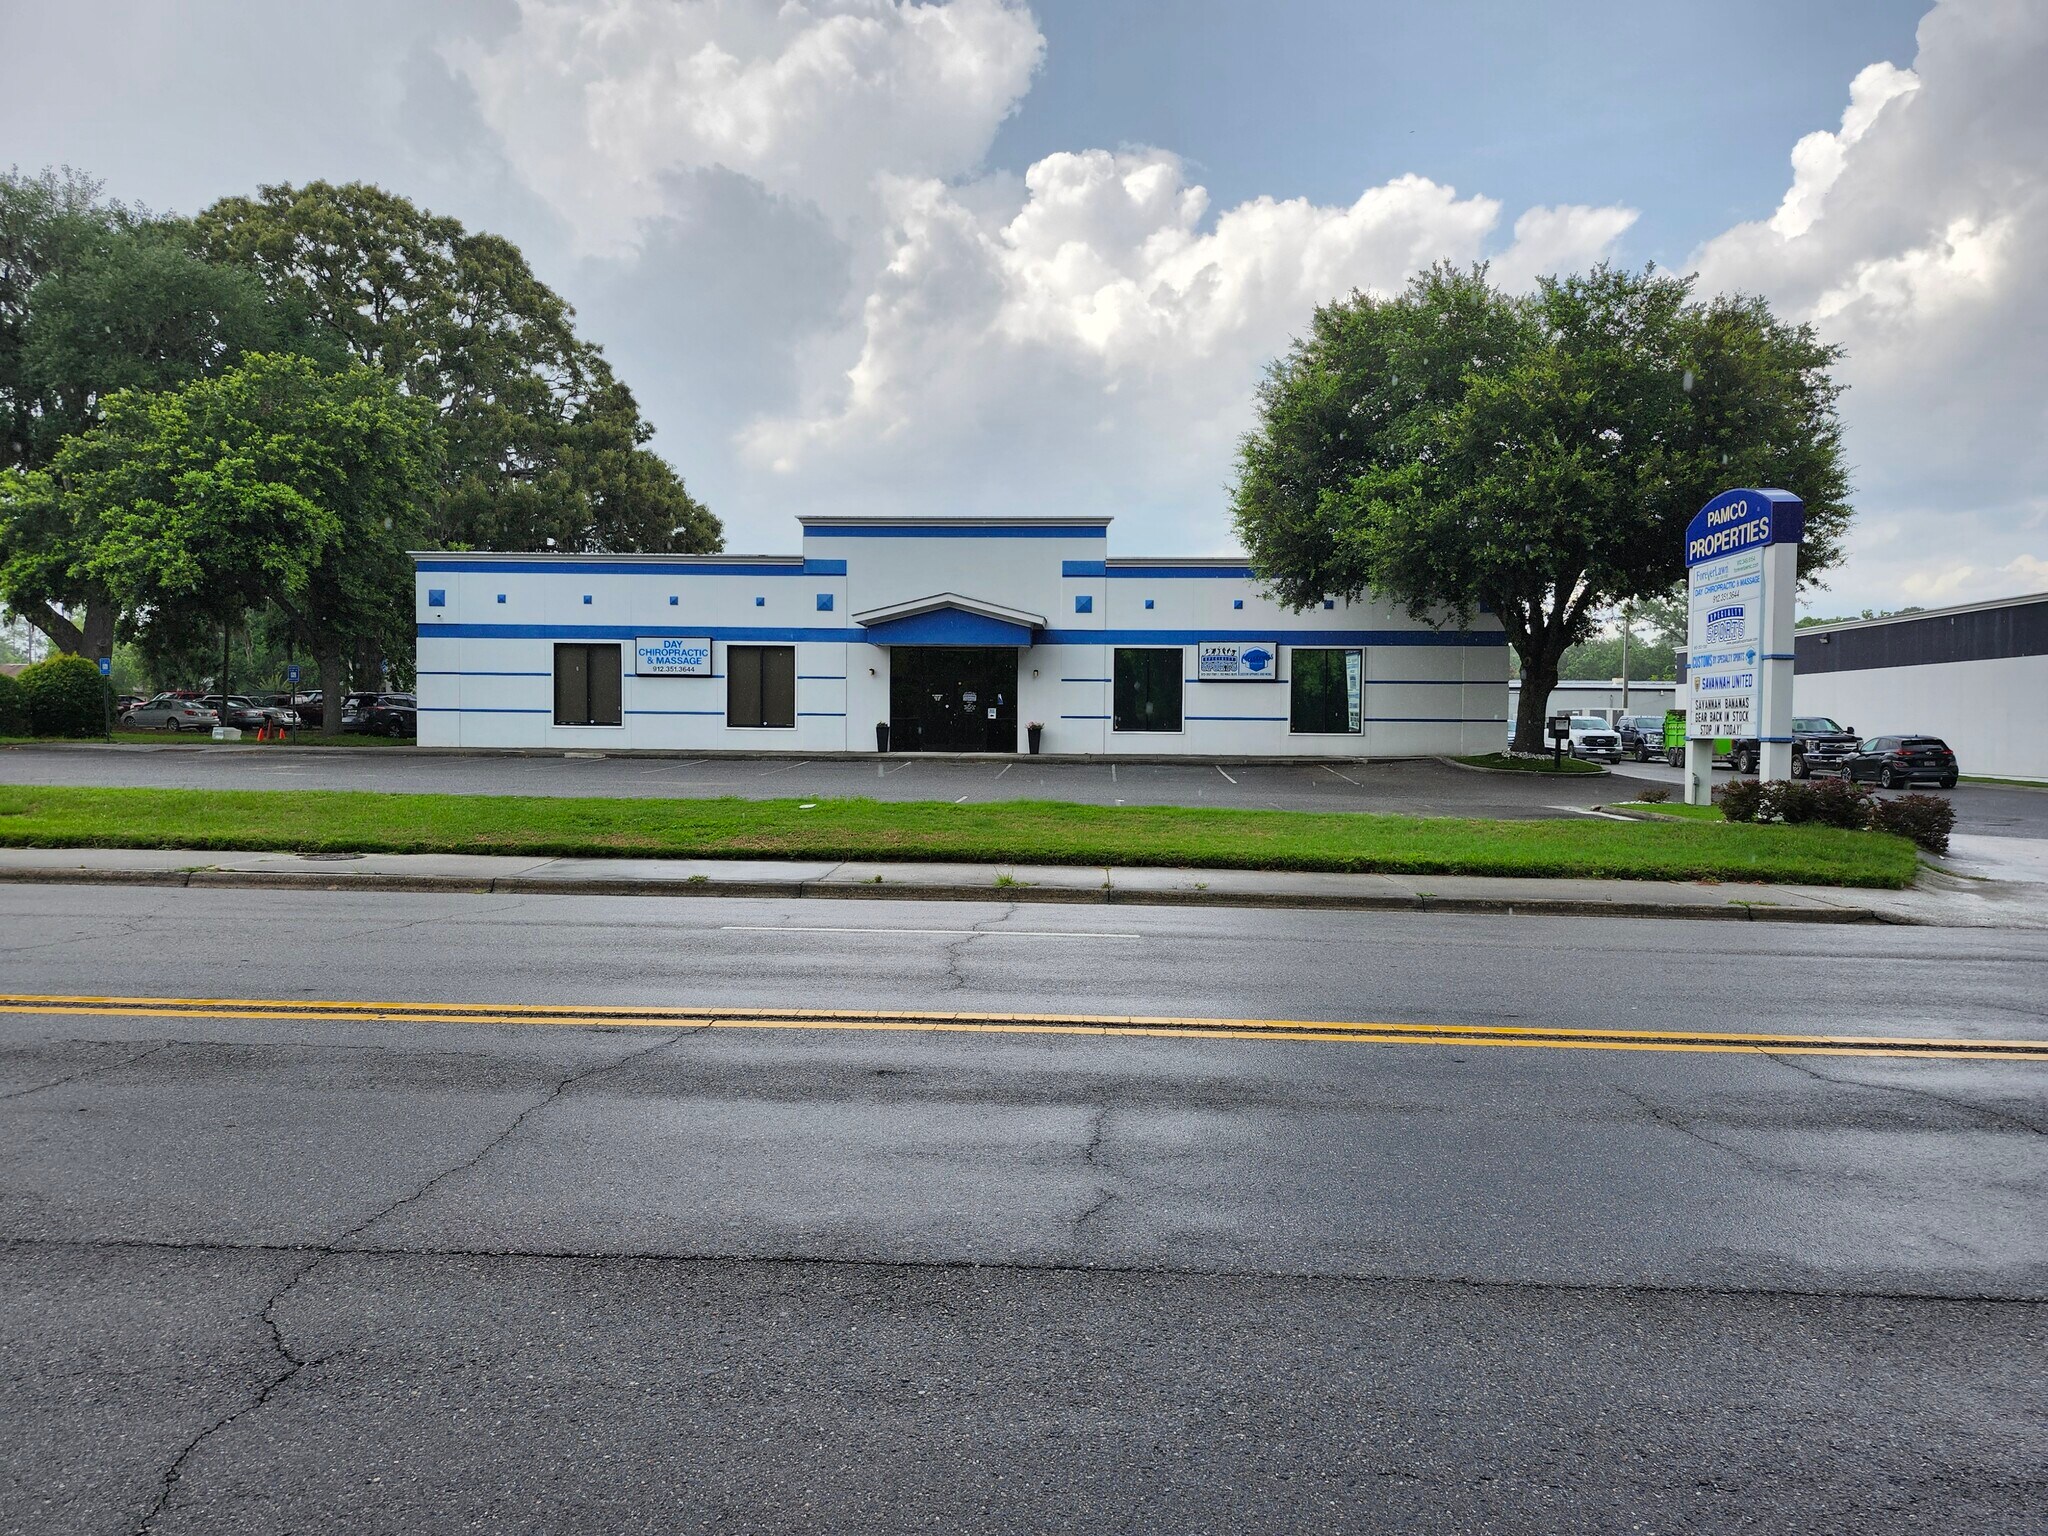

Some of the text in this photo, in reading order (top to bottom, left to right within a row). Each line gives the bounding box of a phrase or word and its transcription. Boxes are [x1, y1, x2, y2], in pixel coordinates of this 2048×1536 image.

[1707, 500, 1747, 528] PAMCO
[1689, 516, 1769, 561] PROPERTIES
[1694, 588, 1704, 597] DAY
[1704, 580, 1736, 595] CHIROPRACTIC
[1740, 574, 1760, 587] MASSAGE
[1709, 607, 1742, 622] SPECIALTY
[1706, 619, 1745, 644] SPORTS
[663, 640, 683, 649] DAY
[638, 648, 709, 657] CHIROPRACTIC
[646, 656, 702, 665] & MASSAGE
[652, 665, 695, 673] 912.351.3644
[1702, 673, 1753, 691] SAVANNAH UNITED
[1695, 697, 1750, 710] SAVANNAH BANANAS
[1695, 710, 1750, 723] GEAR BACK IN STOCK
[1700, 723, 1742, 735] STOP IN TODAY!
